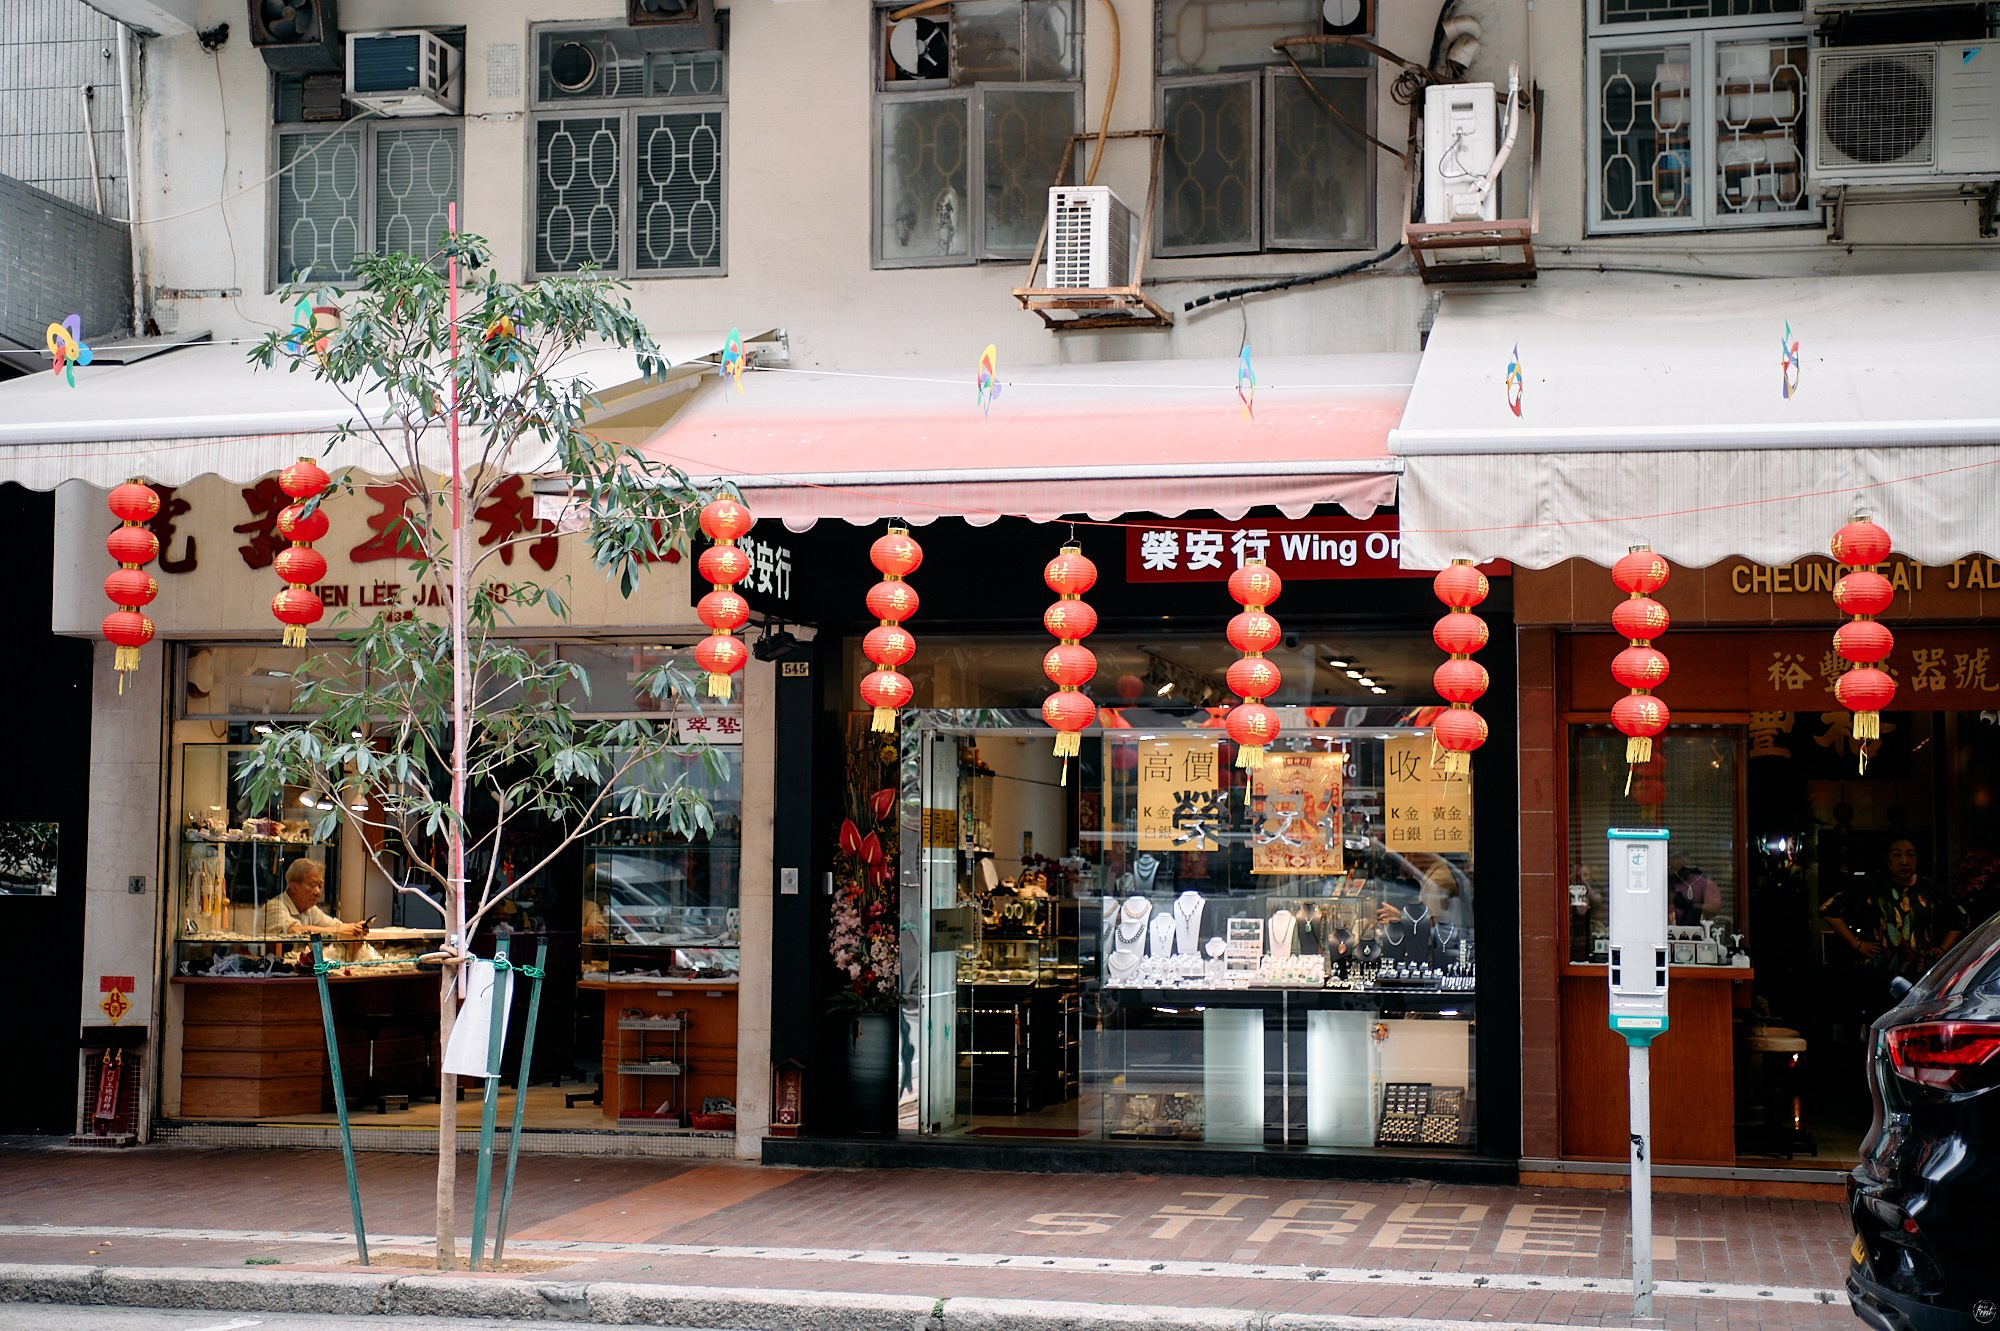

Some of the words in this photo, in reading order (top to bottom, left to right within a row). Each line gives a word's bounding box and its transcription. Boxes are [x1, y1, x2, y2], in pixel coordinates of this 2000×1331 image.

[360, 584, 401, 607] LEE
[714, 506, 740, 663] 生意興隆
[1141, 528, 1271, 571] 榮安行
[1280, 533, 1357, 566] Wing
[784, 663, 808, 674] 545
[879, 541, 914, 696] 生意興隆
[1044, 561, 1069, 720] 財源廣進
[1248, 573, 1272, 738] 財源廣進
[1639, 560, 1667, 727] 財源廣進
[1143, 751, 1213, 783] 高價
[1012, 1212, 1726, 1260] STREET
